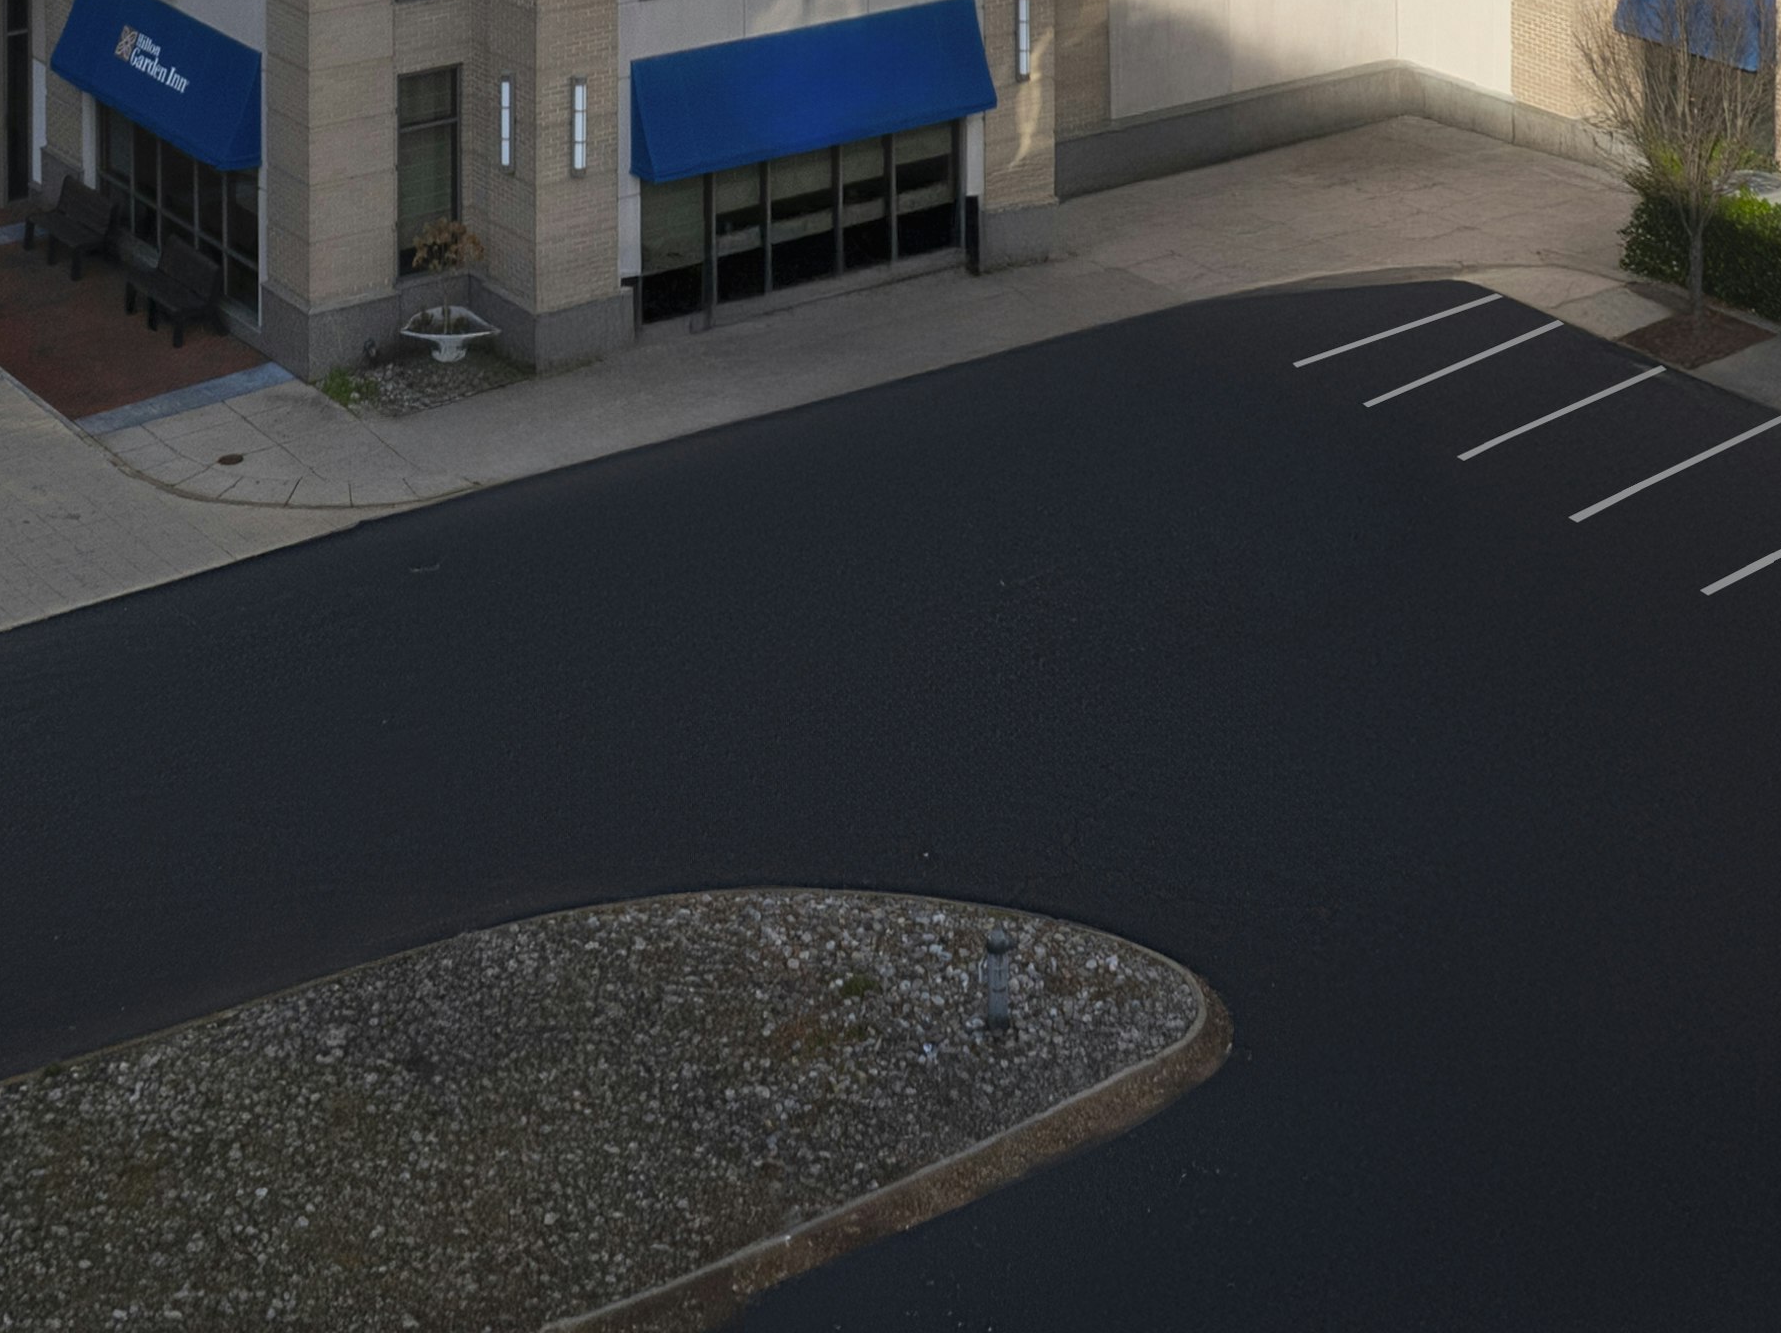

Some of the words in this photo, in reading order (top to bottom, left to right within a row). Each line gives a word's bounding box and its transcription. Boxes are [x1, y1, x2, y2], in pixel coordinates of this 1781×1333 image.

[136, 32, 161, 56] Hilton
[130, 47, 167, 83] Garden
[165, 66, 188, 94] Inn
